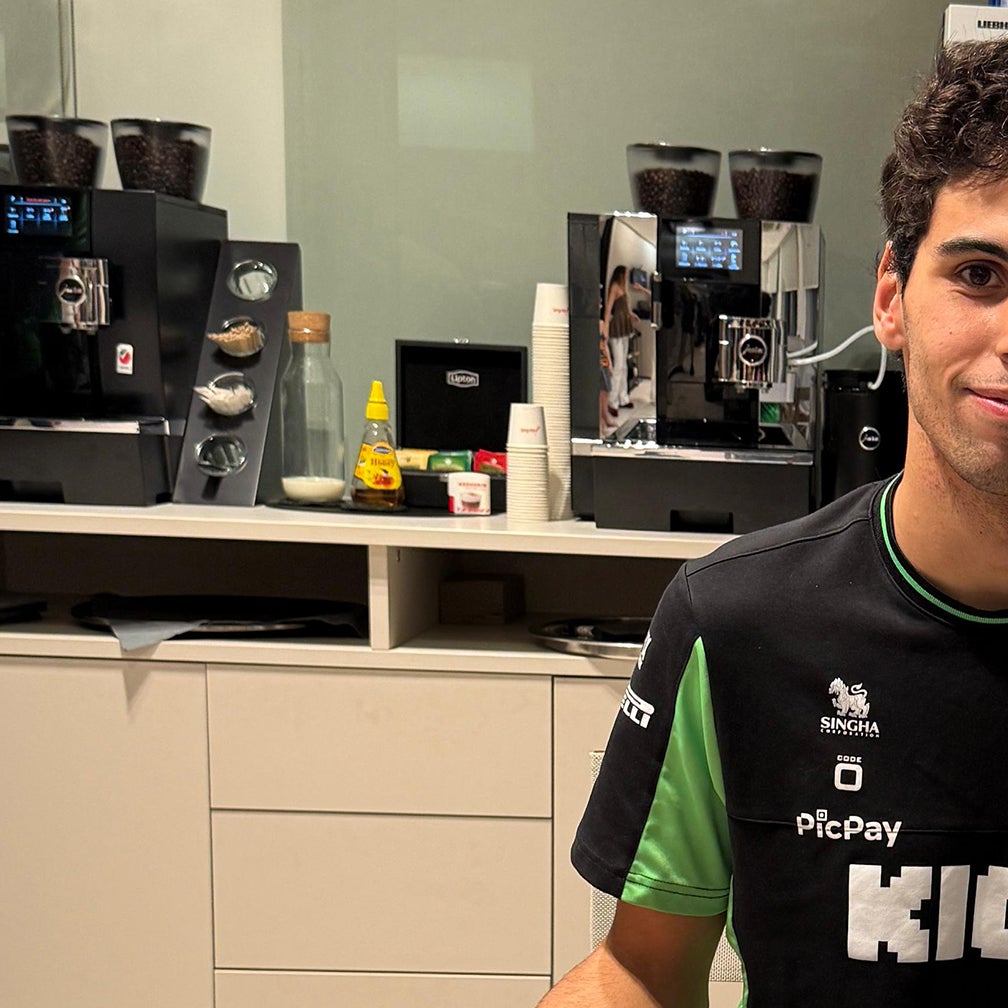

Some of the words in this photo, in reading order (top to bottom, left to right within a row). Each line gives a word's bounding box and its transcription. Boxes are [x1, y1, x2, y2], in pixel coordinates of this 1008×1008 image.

[450, 373, 476, 384] Lipton
[370, 458, 395, 467] Honey
[820, 716, 880, 733] SINGHA
[820, 728, 880, 738] CORPORATION
[837, 754, 862, 763] CODE
[796, 809, 902, 847] PicPay
